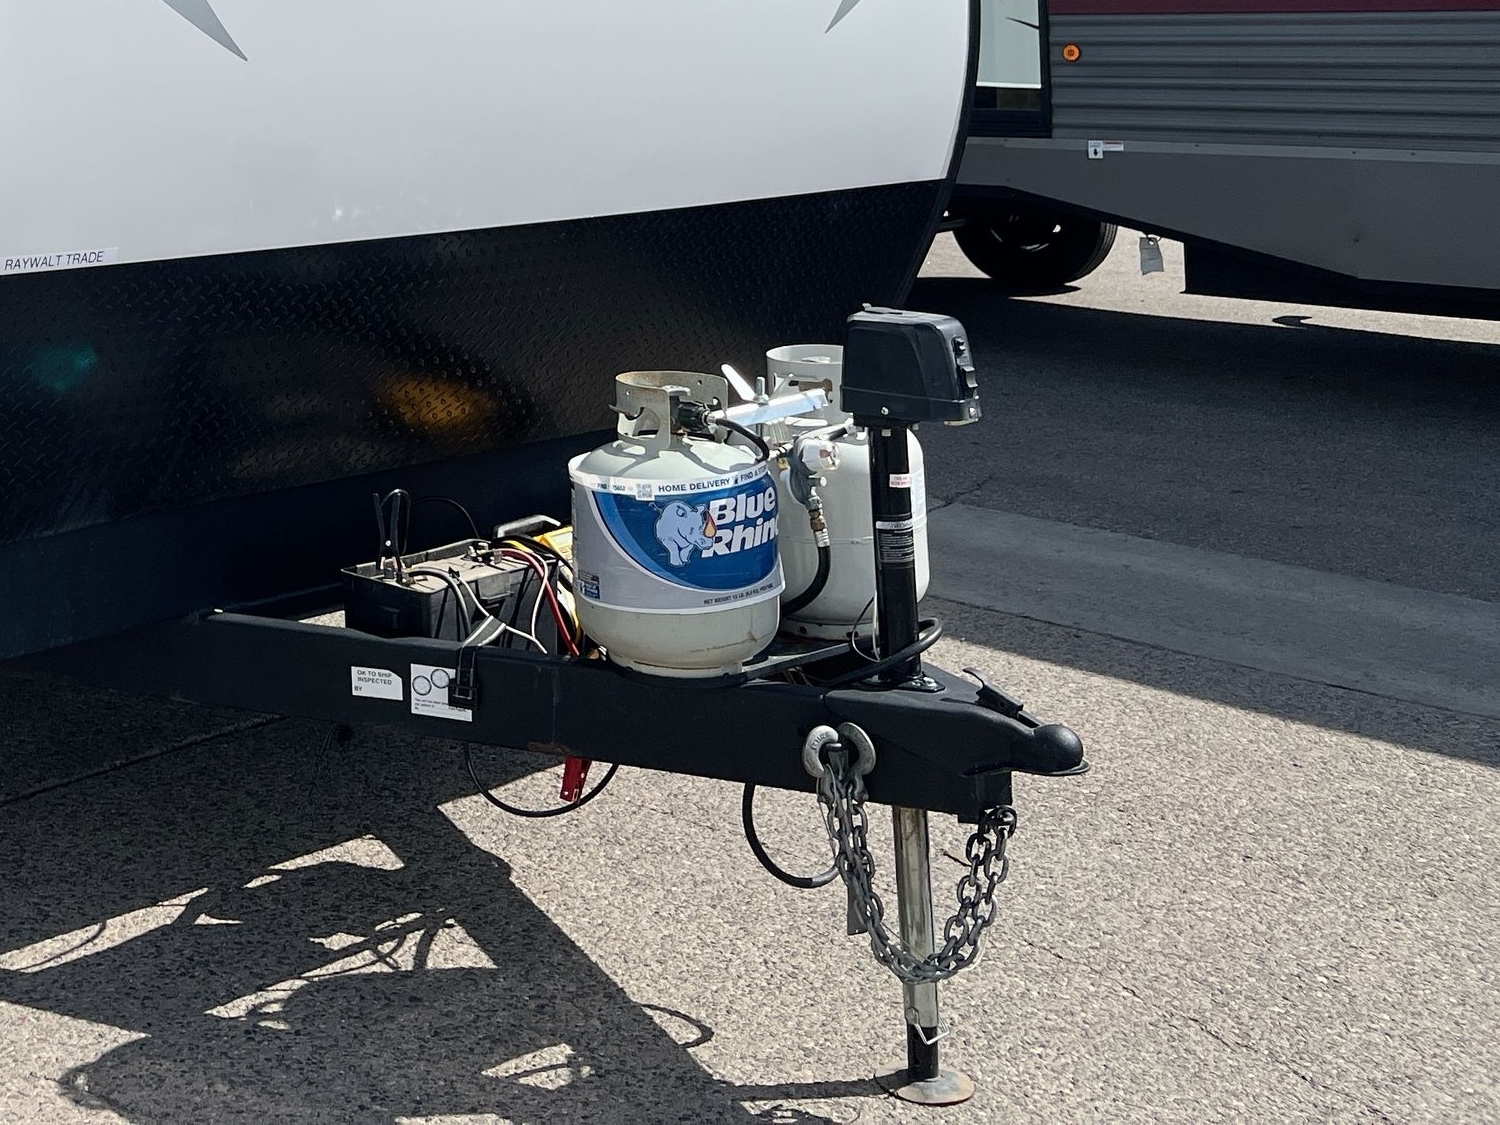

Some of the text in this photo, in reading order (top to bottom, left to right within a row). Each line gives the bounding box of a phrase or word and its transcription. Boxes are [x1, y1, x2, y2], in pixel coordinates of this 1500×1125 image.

[4, 250, 104, 271] RAYWALT TRADE
[740, 471, 754, 482] FIND
[658, 478, 731, 493] HOME DELIVERY
[708, 486, 776, 526] Blue
[357, 676, 392, 685] INSPECTED
